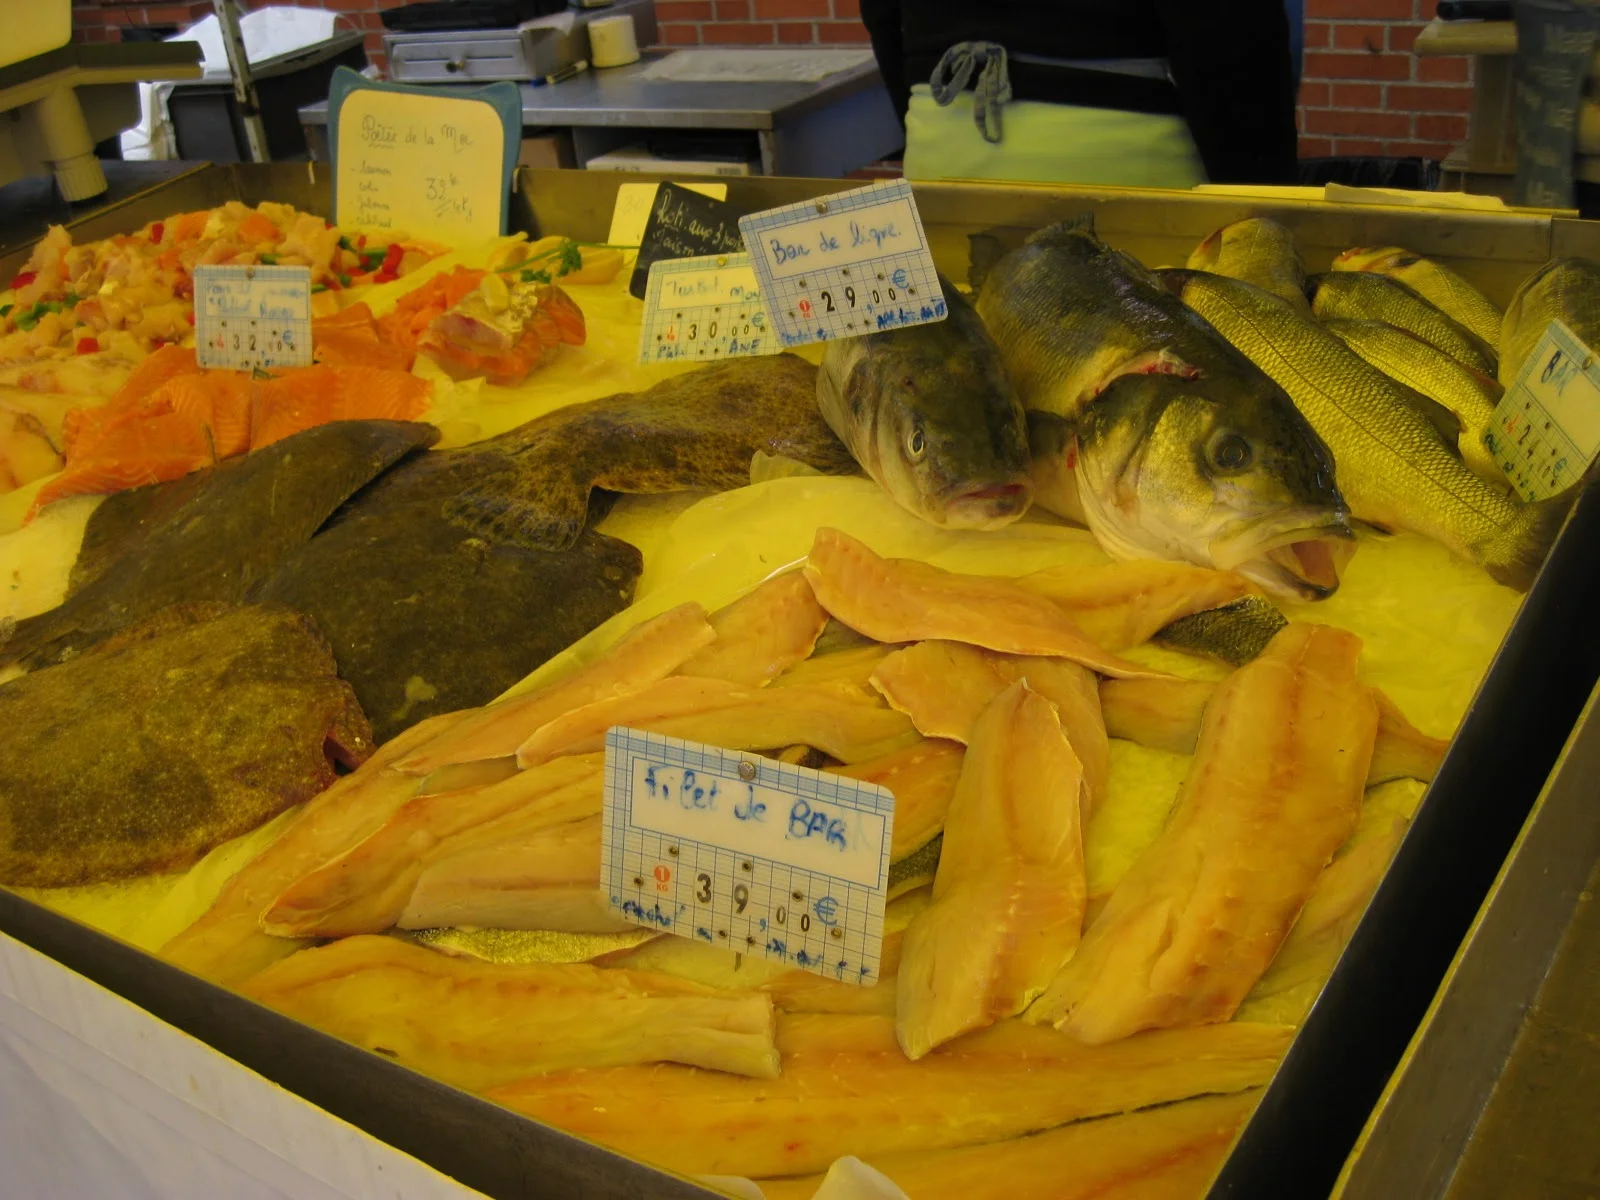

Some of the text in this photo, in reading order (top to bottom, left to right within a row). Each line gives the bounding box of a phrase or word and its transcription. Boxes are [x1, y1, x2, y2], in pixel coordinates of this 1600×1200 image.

[406, 128, 417, 144] de
[424, 128, 435, 145] la
[819, 231, 840, 251] de
